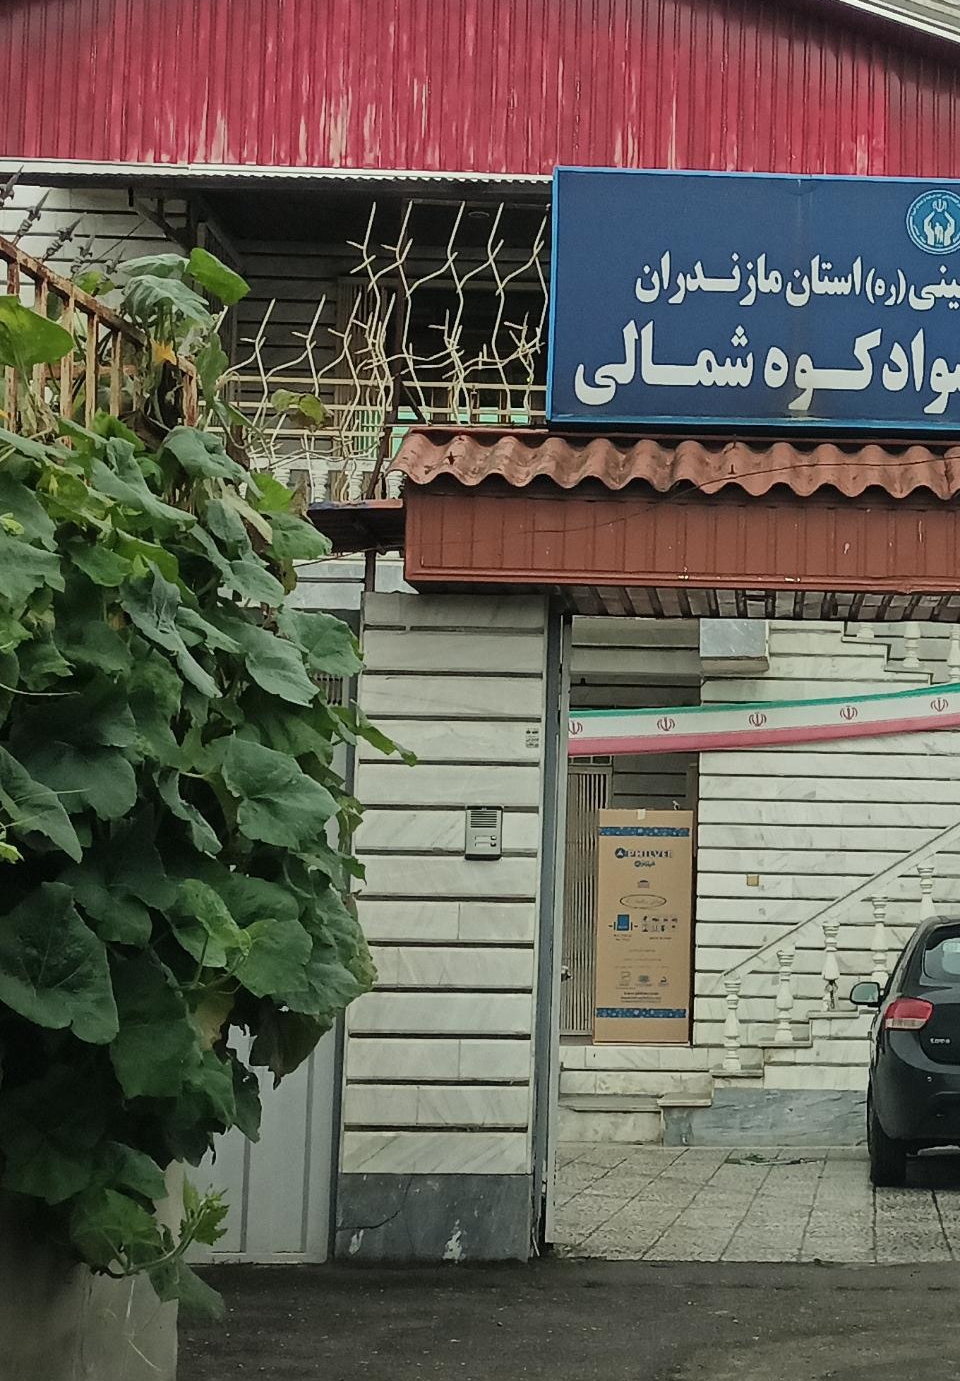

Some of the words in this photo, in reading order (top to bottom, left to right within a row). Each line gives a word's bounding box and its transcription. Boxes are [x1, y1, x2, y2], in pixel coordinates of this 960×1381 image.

[635, 250, 782, 306] مازندران
[785, 254, 863, 307] استان
[866, 268, 906, 306] (ره)
[574, 319, 754, 406] شمالی
